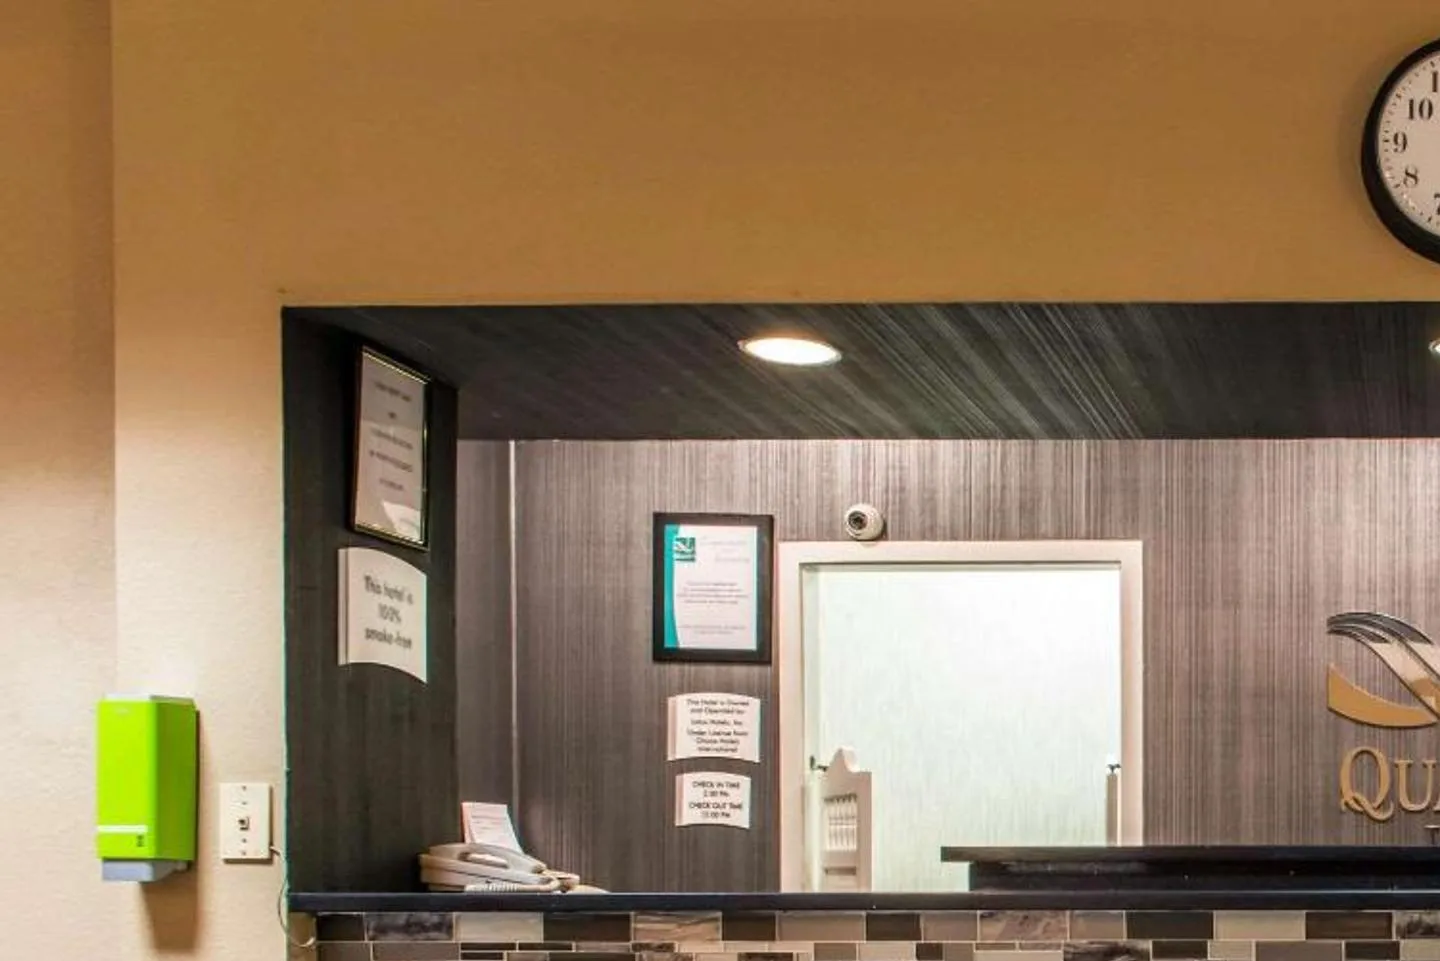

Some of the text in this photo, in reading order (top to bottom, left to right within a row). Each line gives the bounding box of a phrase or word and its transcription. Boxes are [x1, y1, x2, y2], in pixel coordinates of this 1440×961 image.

[1408, 98, 1433, 120] 10
[1393, 132, 1407, 153] 9
[1403, 165, 1418, 188] 8
